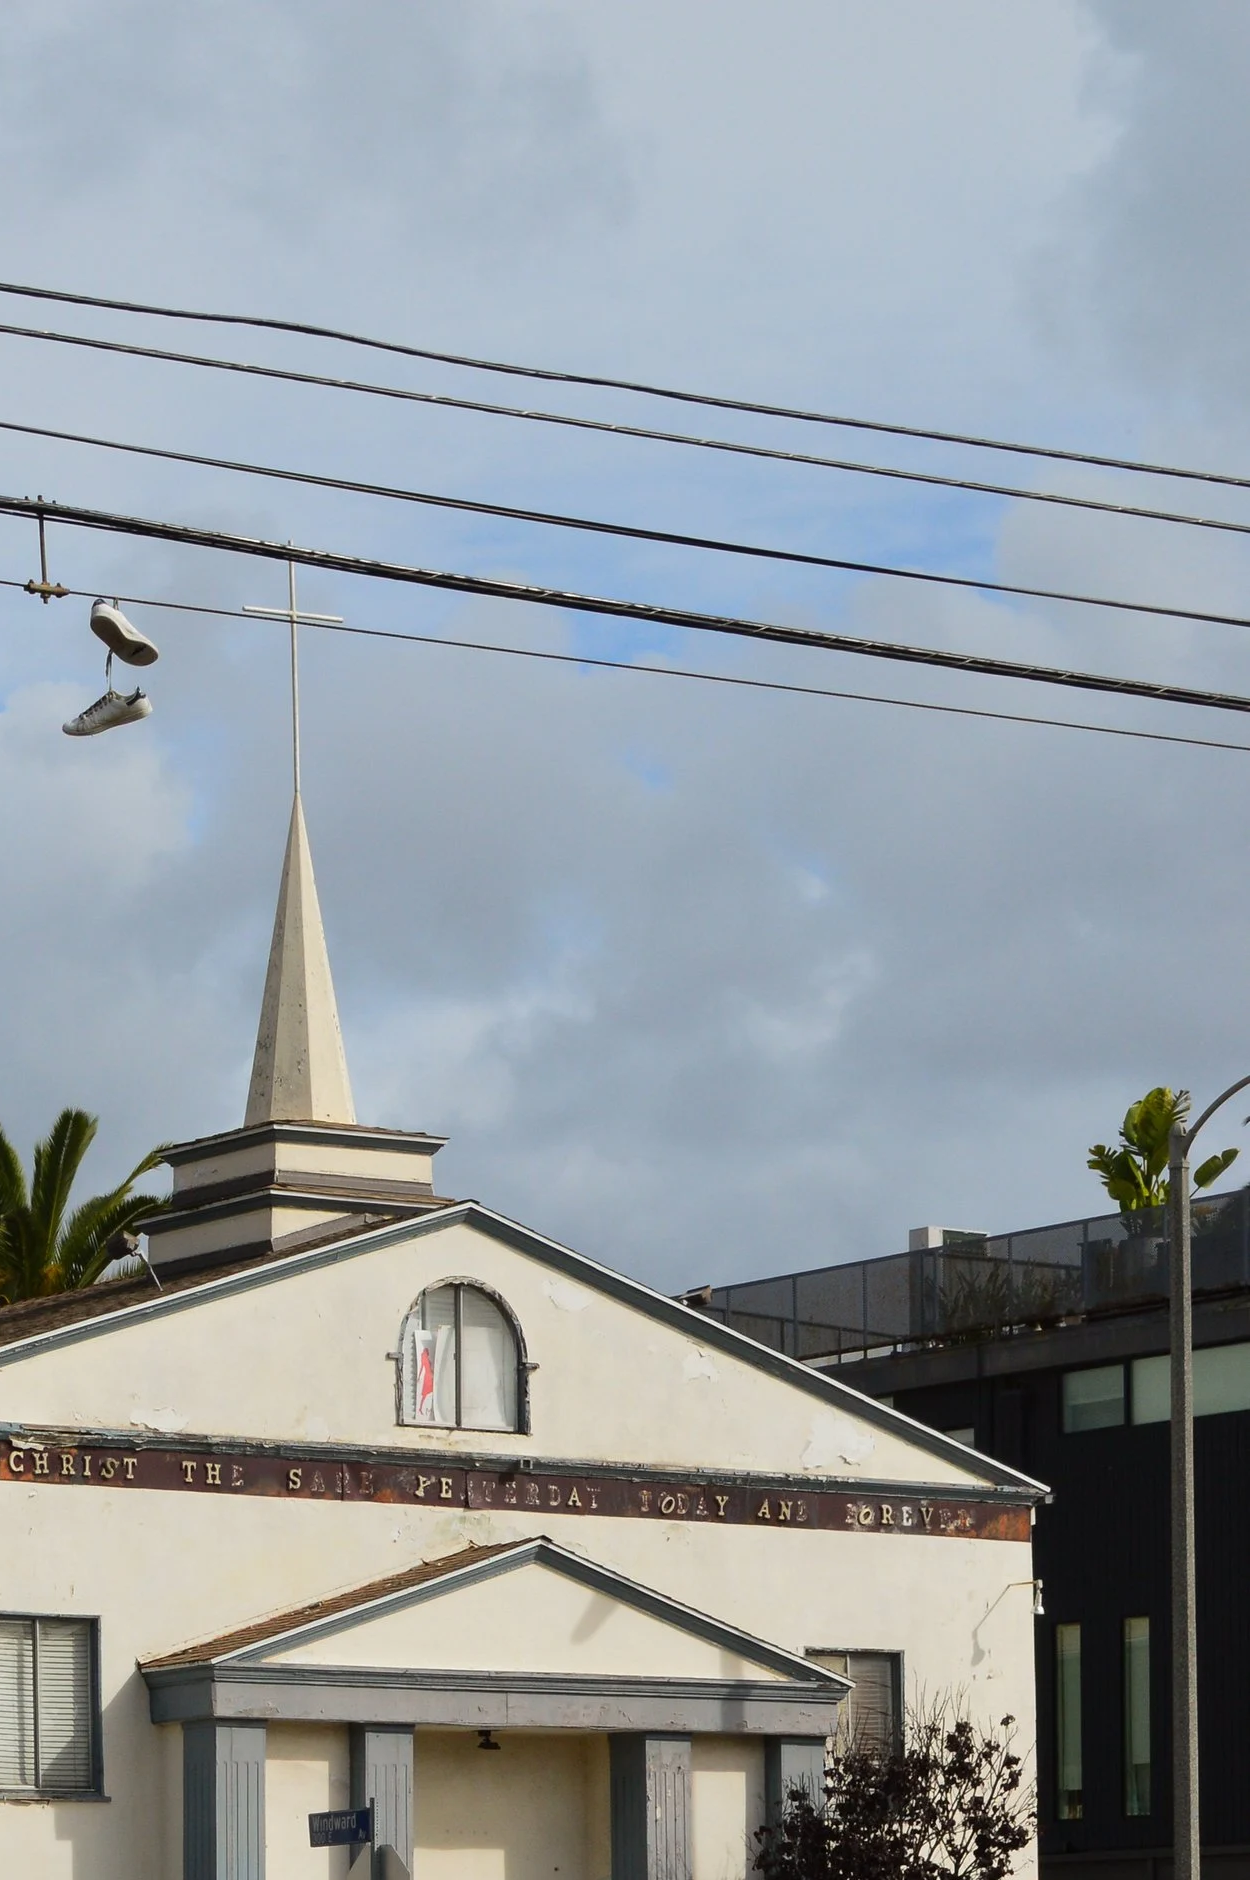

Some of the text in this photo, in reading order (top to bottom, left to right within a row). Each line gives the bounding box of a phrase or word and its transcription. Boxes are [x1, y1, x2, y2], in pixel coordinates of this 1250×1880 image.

[9, 1449, 137, 1480] CHRIST
[181, 1460, 244, 1486] THE
[638, 1489, 729, 1517] TODAY
[758, 1497, 809, 1522] AND
[312, 1813, 356, 1833] Windward
